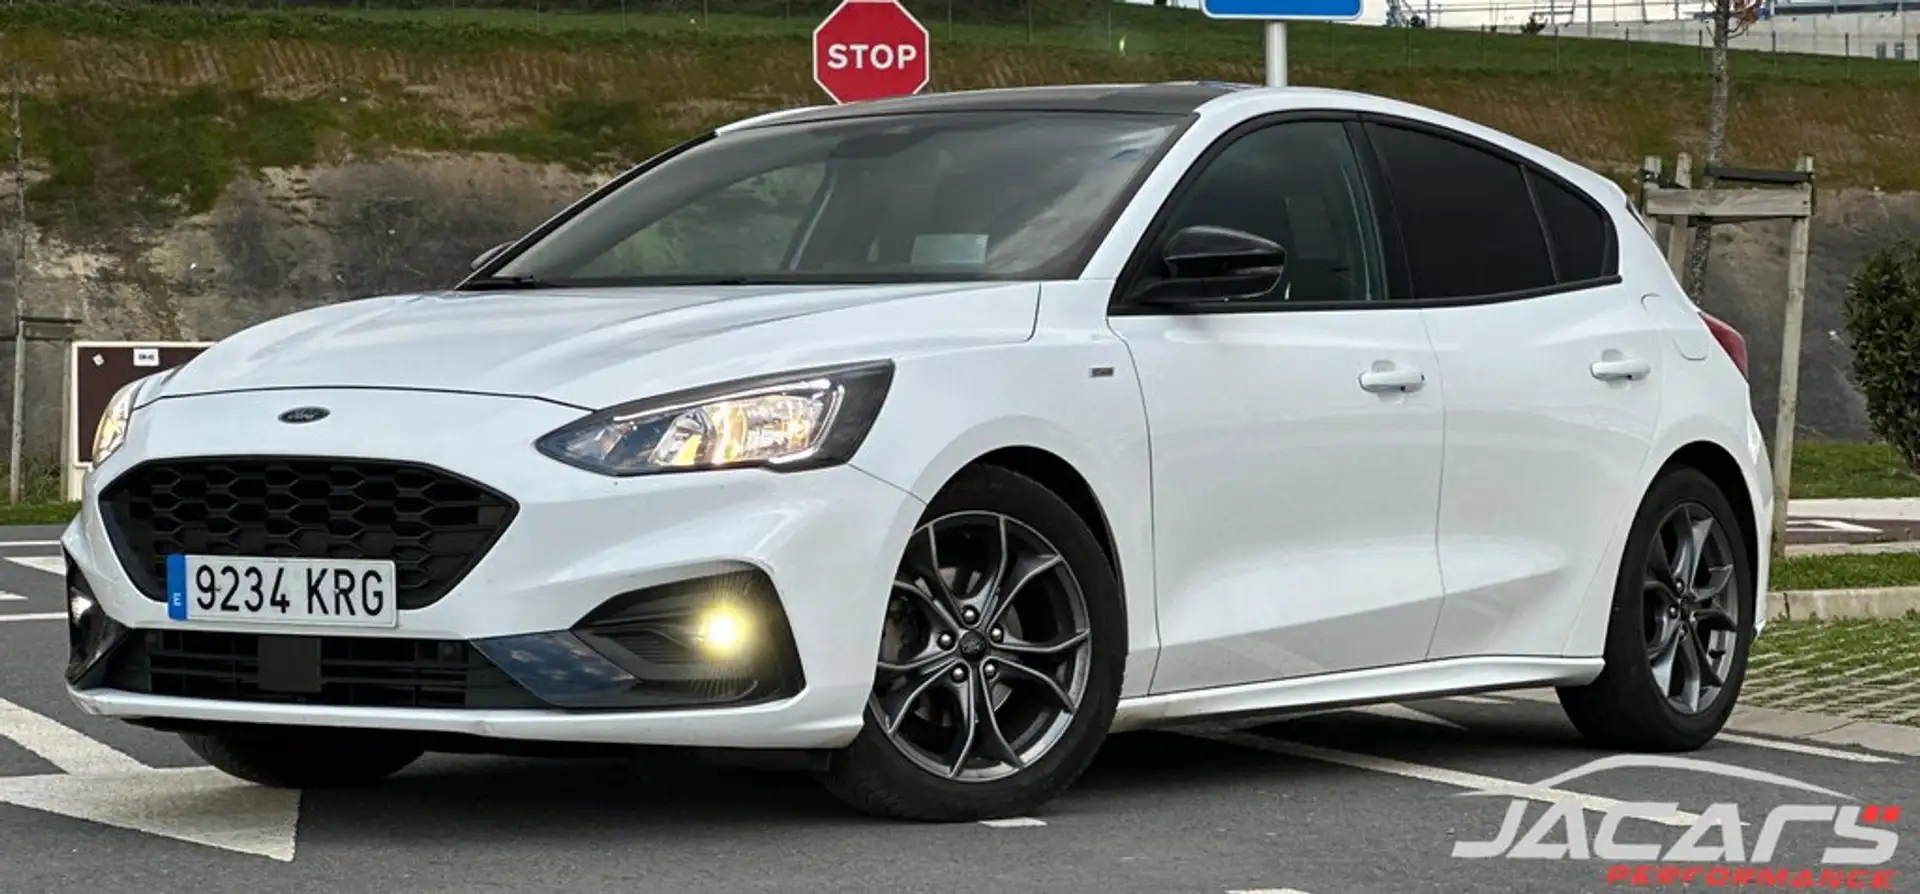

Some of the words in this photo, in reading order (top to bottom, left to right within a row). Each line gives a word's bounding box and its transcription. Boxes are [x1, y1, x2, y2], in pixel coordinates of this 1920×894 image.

[827, 43, 917, 70] STOP
[172, 592, 182, 606] E
[195, 564, 290, 613] 9234
[305, 567, 384, 616] KRG
